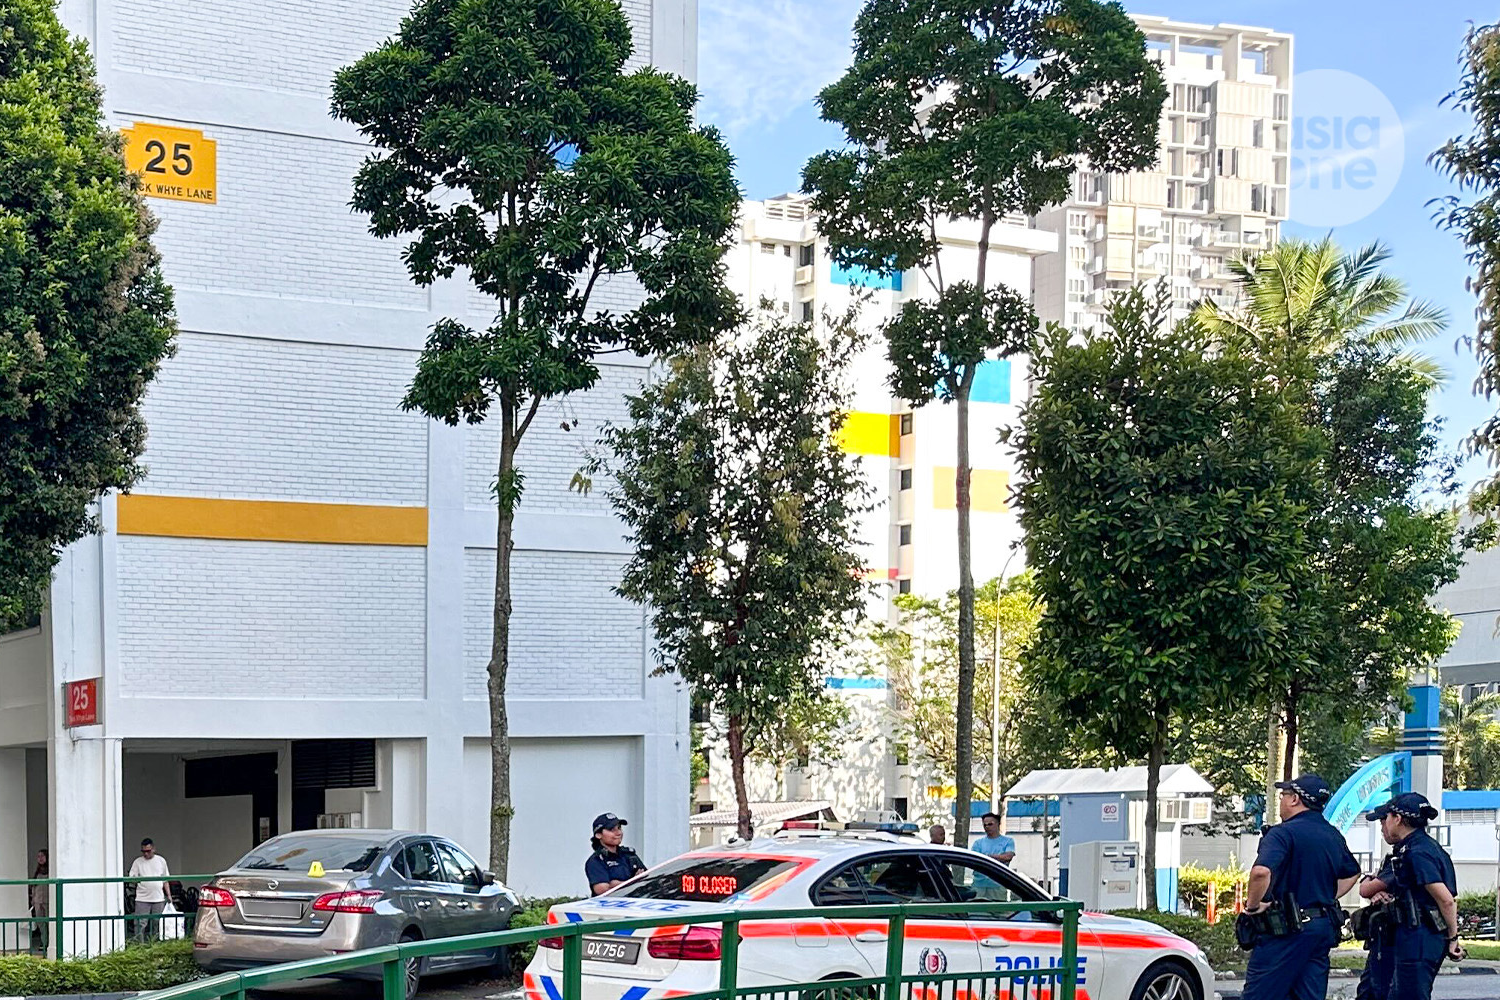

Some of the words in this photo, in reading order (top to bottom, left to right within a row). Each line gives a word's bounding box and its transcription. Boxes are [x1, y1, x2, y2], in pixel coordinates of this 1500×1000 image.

[145, 140, 193, 176] 25
[156, 184, 183, 197] WHYE
[187, 188, 213, 200] LANE
[73, 685, 88, 710] 25
[682, 875, 695, 893] RD
[699, 876, 737, 895] CLOSED
